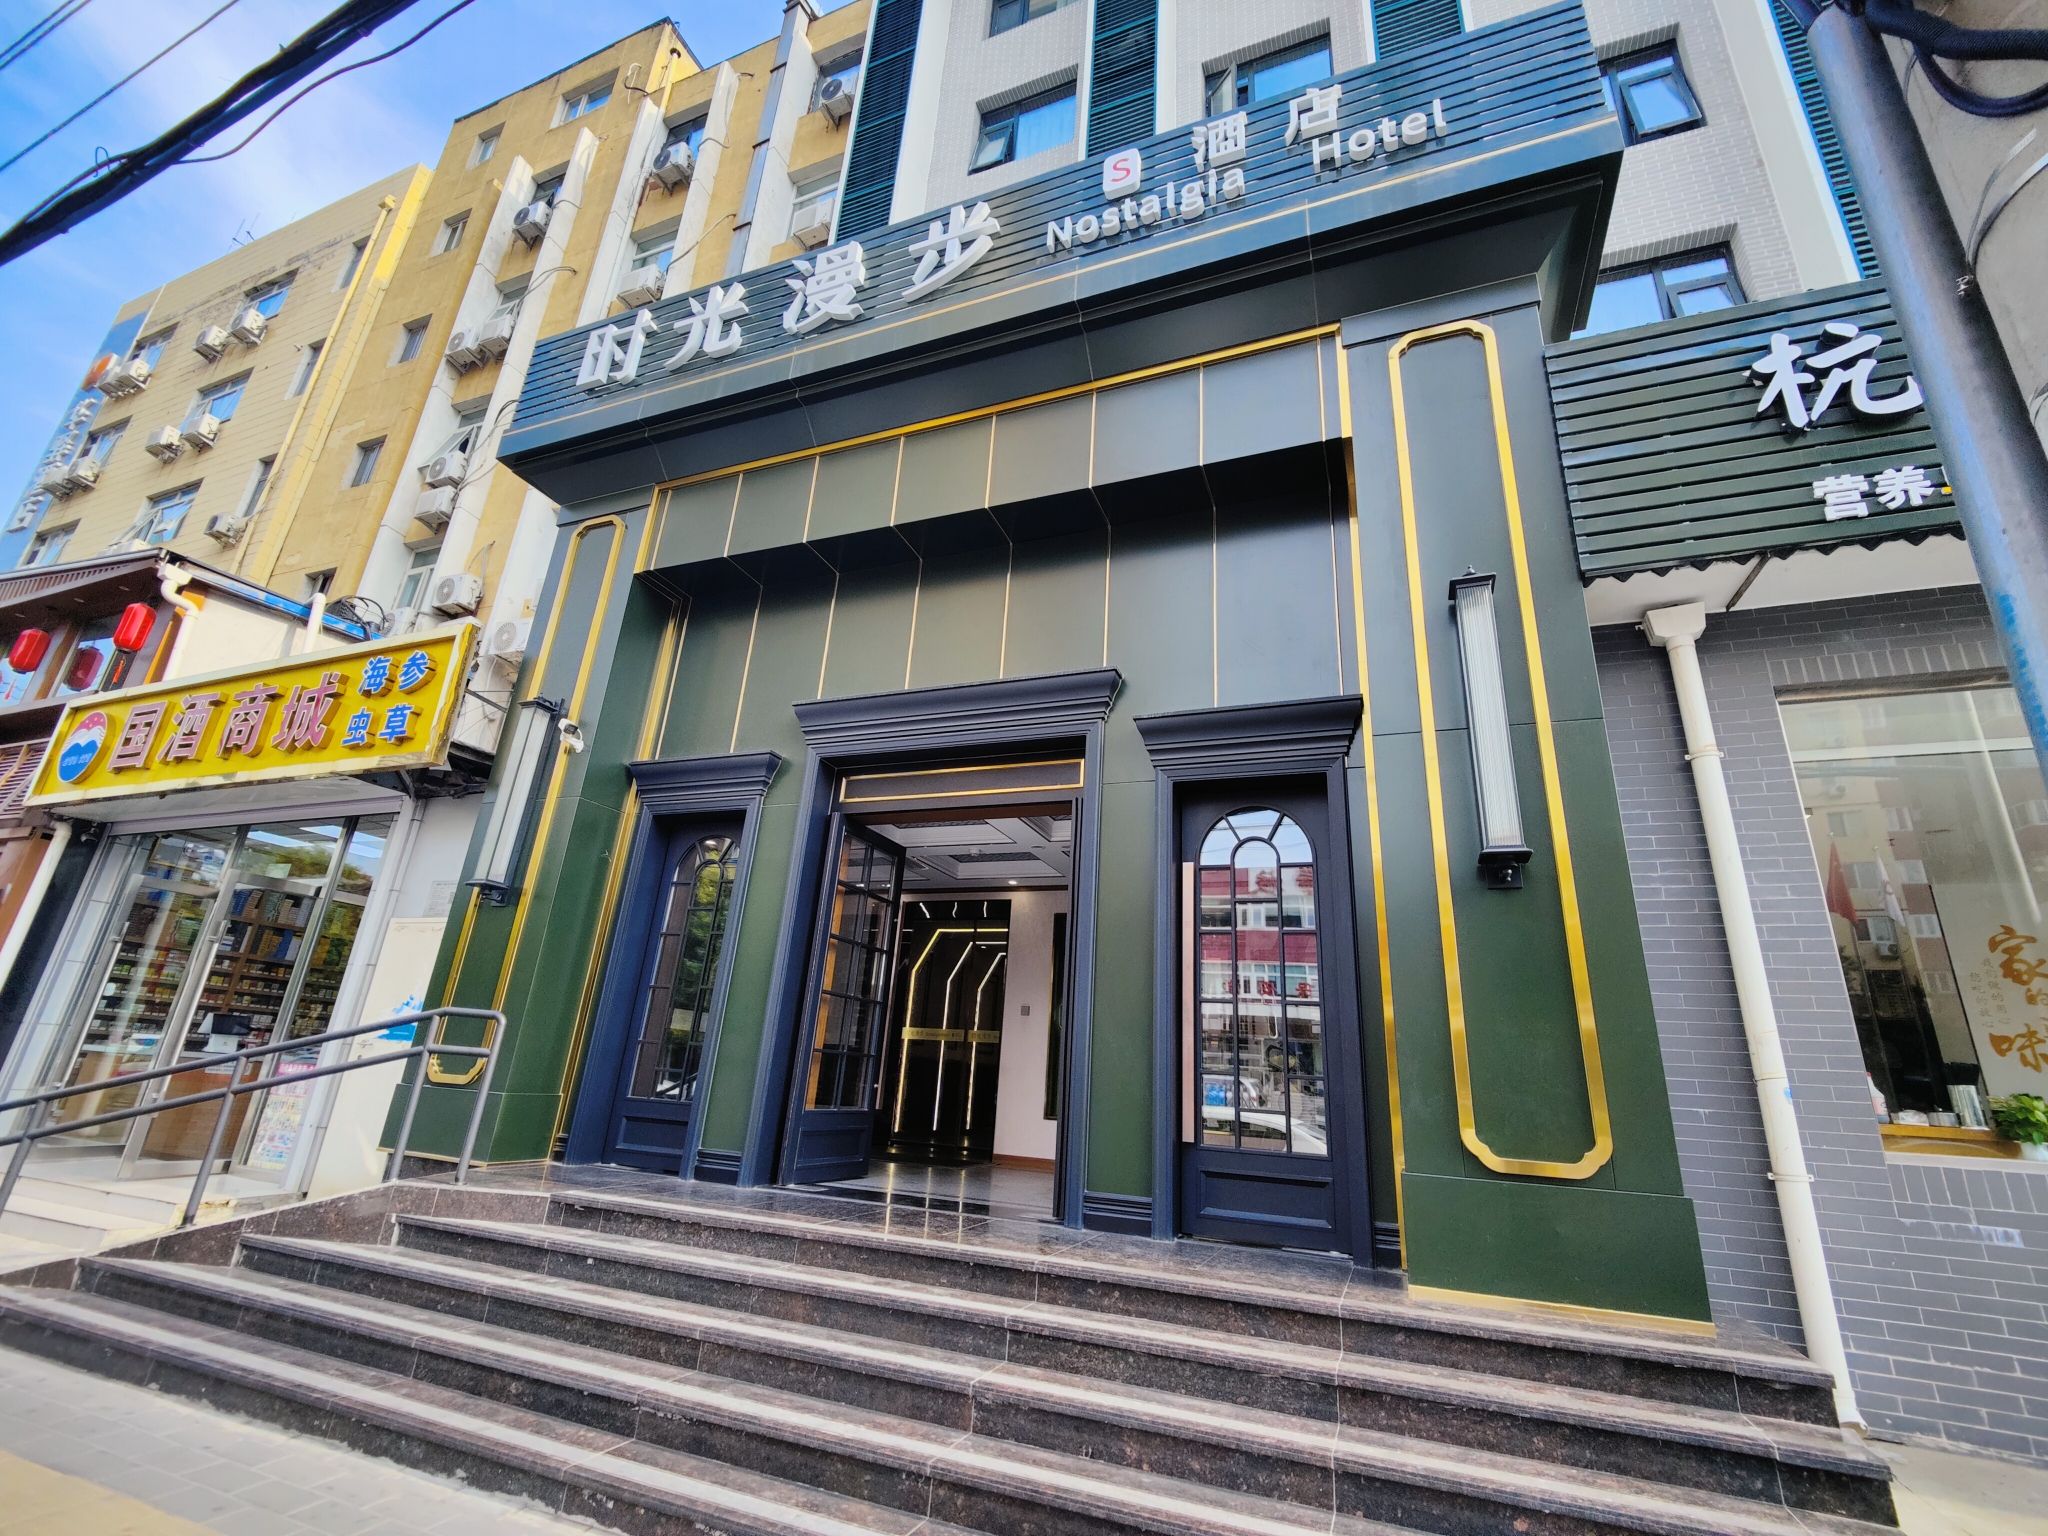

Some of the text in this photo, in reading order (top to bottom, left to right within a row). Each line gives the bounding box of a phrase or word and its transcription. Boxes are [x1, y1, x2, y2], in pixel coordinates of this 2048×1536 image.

[1047, 98, 1447, 253] Nostalgia Hotel
[576, 84, 1343, 388] 时光漫步 酒店
[106, 672, 342, 773] 国酒商城
[357, 651, 436, 697] 海参
[340, 704, 415, 748] 虫草
